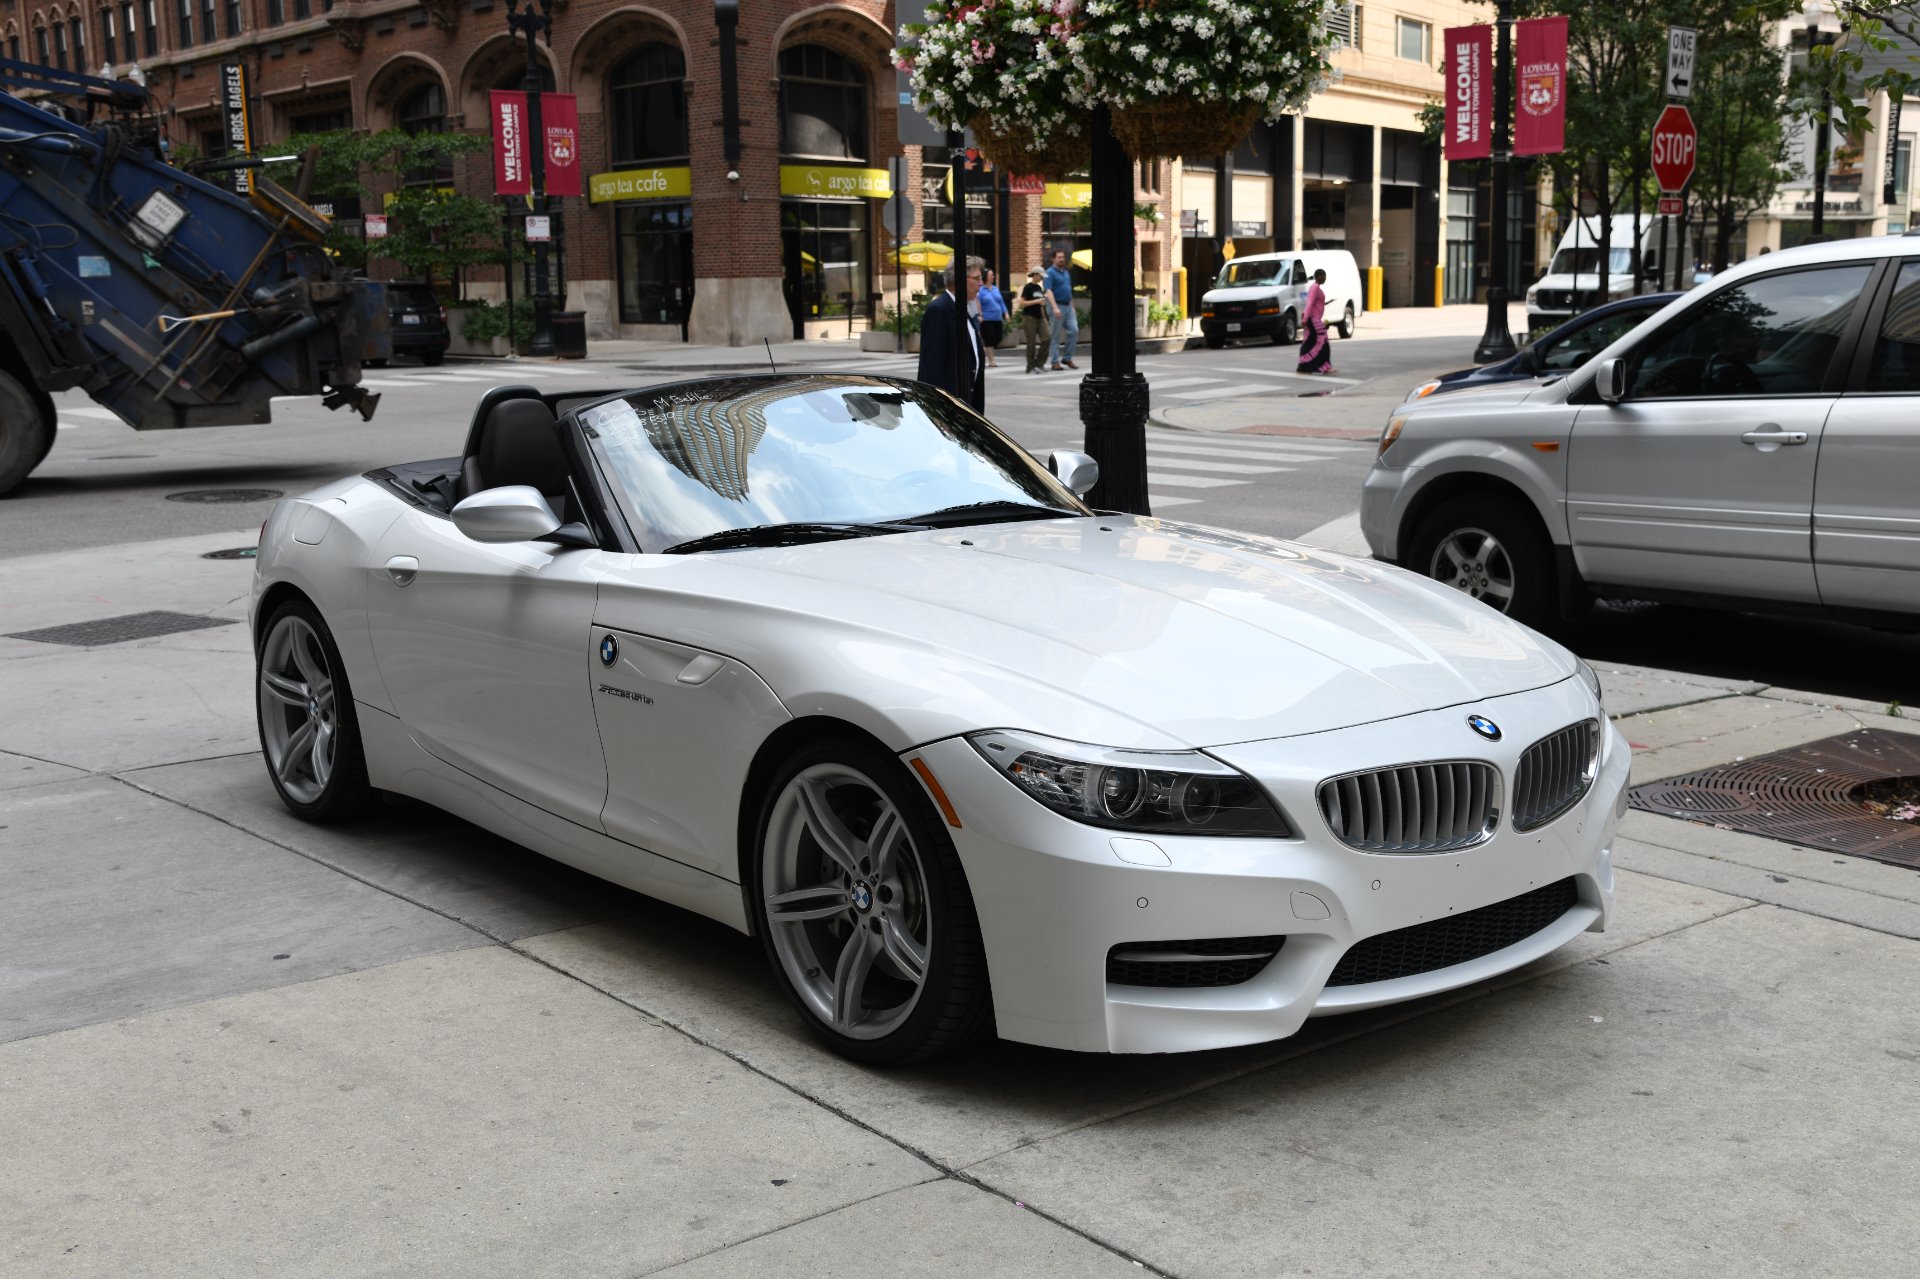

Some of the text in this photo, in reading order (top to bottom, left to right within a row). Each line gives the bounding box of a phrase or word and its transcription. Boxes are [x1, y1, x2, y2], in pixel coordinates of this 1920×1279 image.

[1672, 33, 1693, 51] ONE
[1522, 63, 1560, 74] LOYOLA
[1671, 54, 1692, 71] WAY
[226, 66, 242, 108] BAGELS
[1456, 42, 1471, 143] WELCOME
[1471, 42, 1480, 142] WATER TOWER CAMPUS
[501, 103, 515, 182] WELCOME
[547, 127, 574, 136] LOYOLA
[1655, 132, 1694, 165] STOP
[599, 170, 667, 200] argo tea café
[828, 176, 856, 194] argo
[859, 176, 872, 191] tea
